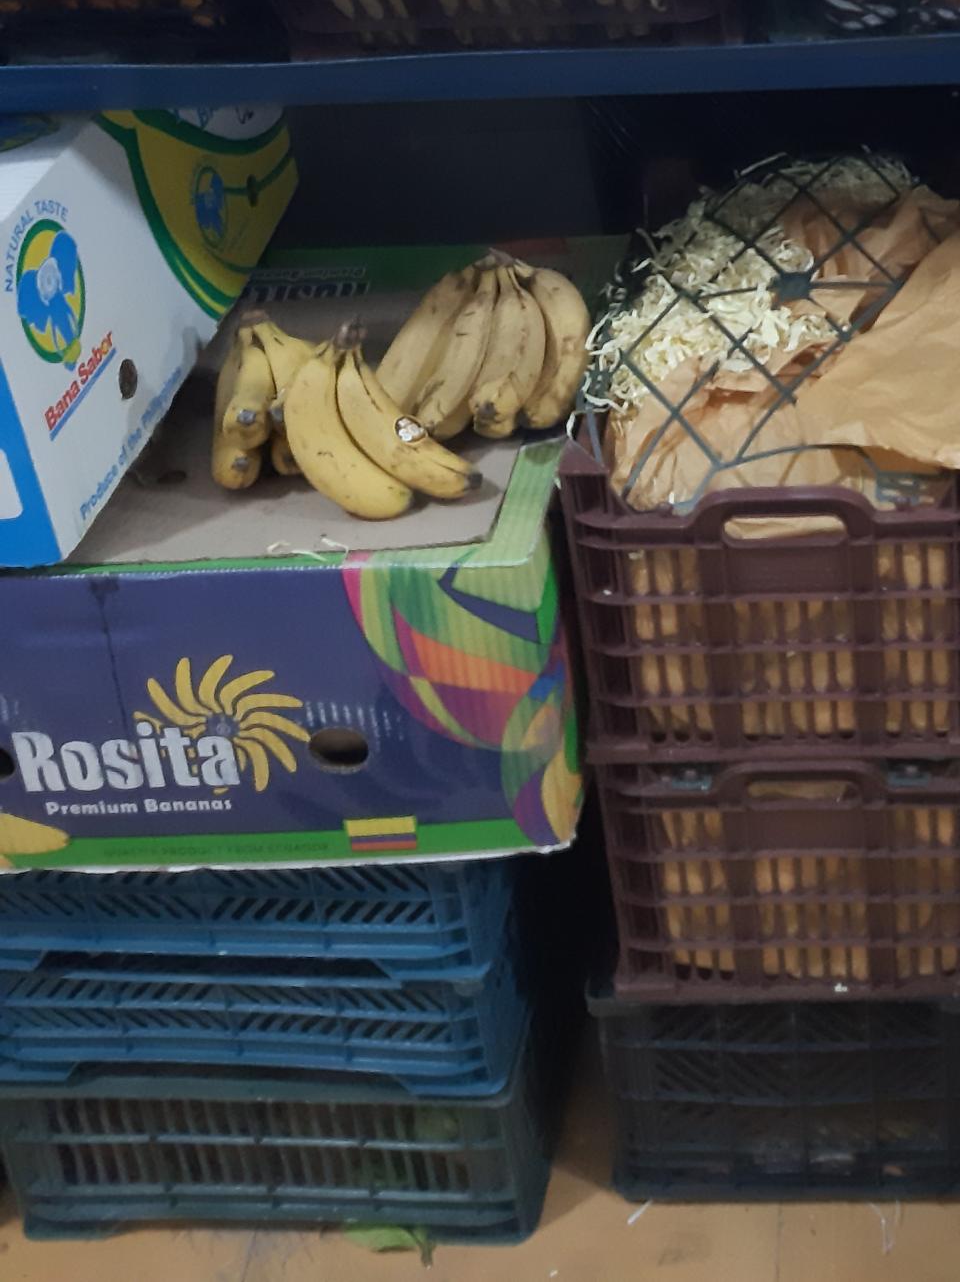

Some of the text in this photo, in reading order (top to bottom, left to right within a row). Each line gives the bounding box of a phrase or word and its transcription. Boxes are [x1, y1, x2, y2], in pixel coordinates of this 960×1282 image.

[5, 199, 69, 292] NATURAL TASTE
[45, 330, 113, 431] Bana Sabor
[80, 464, 118, 520] Produce
[11, 721, 241, 792] Rosita
[46, 798, 233, 816] Premium Bananas
